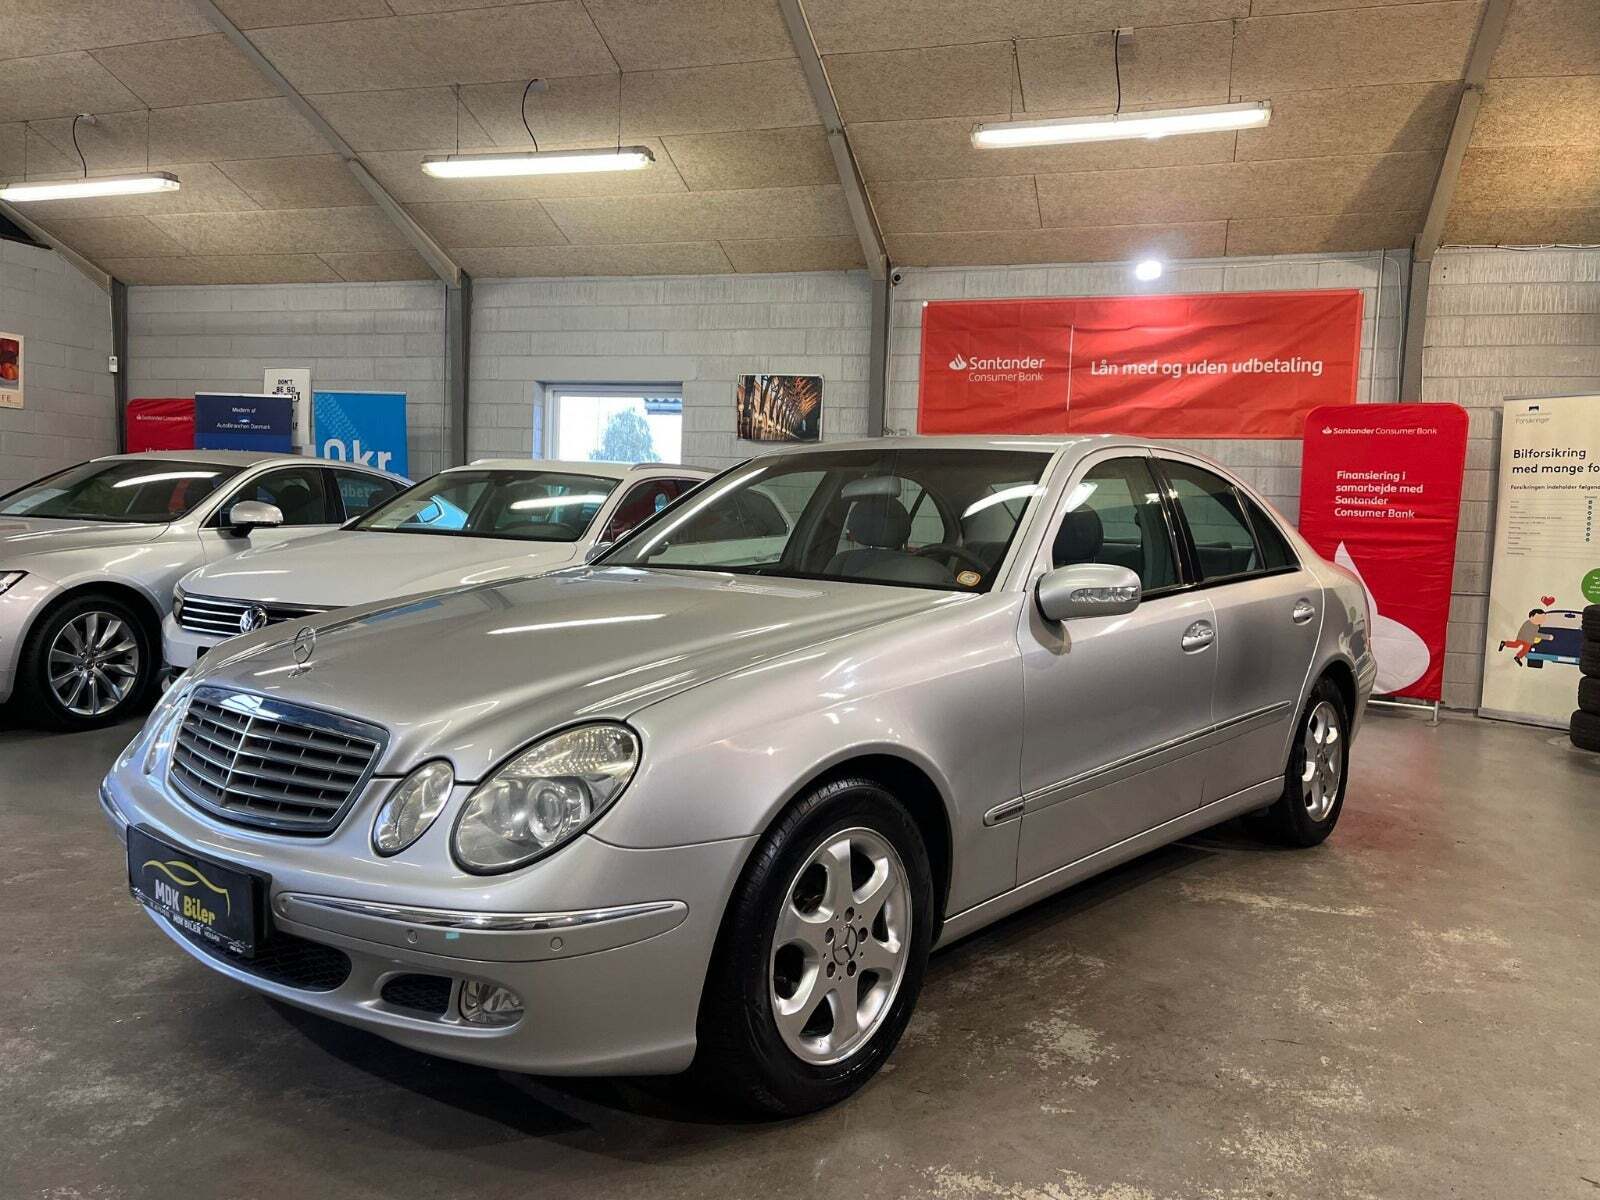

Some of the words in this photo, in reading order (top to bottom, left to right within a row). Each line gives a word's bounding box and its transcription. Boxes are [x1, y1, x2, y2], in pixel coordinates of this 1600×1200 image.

[968, 355, 1046, 371] Santander
[1091, 358, 1118, 376] Lån
[1122, 359, 1158, 375] med
[1161, 362, 1182, 379] og
[1186, 359, 1228, 375] uden
[1232, 356, 1324, 378] udbetaling
[968, 372, 1017, 383] Consumer
[1018, 372, 1044, 382] Bank
[1333, 427, 1375, 435] Santander
[1375, 427, 1416, 435] Consumer
[1416, 427, 1438, 435] Bank
[1513, 447, 1587, 460] Bilforsikring
[1512, 463, 1538, 474] med
[1541, 464, 1584, 476] mange
[1588, 462, 1600, 473] fo
[1336, 470, 1401, 482] Finansiering
[1402, 471, 1406, 480] i
[1335, 483, 1397, 495] samarbejde
[1399, 484, 1424, 494] med
[1335, 495, 1389, 505] Santander
[1334, 507, 1387, 518] Consumer
[1387, 508, 1415, 519] Bank
[154, 879, 180, 912] MDK
[183, 895, 216, 926] Biler
